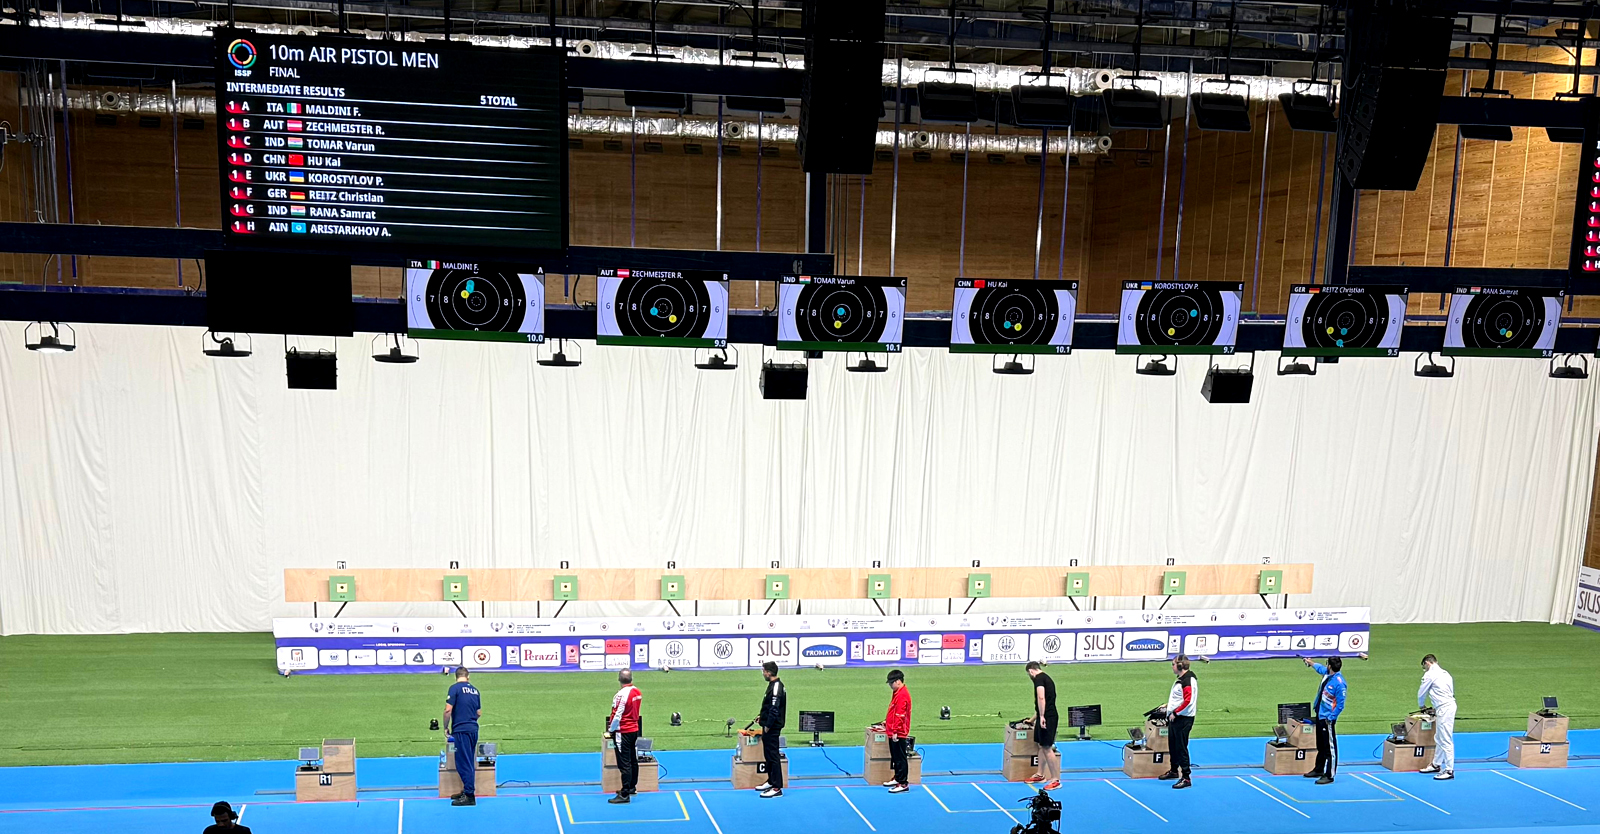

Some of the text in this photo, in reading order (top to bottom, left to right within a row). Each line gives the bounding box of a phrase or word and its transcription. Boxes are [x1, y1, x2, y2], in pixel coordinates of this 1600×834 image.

[270, 45, 438, 68] 10m AIR PISTOL MEN
[270, 67, 300, 78] FINAL
[227, 82, 345, 97] INTERMEDIATE RESULTS
[228, 100, 362, 116] 1 A ITA MALDINI F.
[230, 118, 384, 136] 1 B AUT ZECHMEISTER R.
[230, 136, 374, 152] 1 C IND TOMAR Varun
[232, 152, 340, 166] 1 D CHN HU Kai
[232, 170, 384, 186] 1 E UKR KOROSTYLOV P.
[1594, 172, 1600, 180] 1
[232, 186, 384, 202] 1 F GER REITZ Christian
[1594, 186, 1598, 194] 1
[1592, 202, 1596, 210] 1
[234, 204, 376, 220] 1 G IND RANA Samrat
[1590, 216, 1594, 224] 1
[234, 220, 392, 236] 1 H AIN ARISTARKHOV A.
[1588, 230, 1592, 240] 1
[1586, 246, 1592, 254] 1
[442, 262, 472, 270] MALDINI
[1586, 260, 1590, 268] 1
[632, 270, 676, 278] ZECHMEISTER
[1154, 282, 1194, 290] KOROSTYLOV
[430, 294, 434, 302] 7
[444, 296, 448, 304] 8
[518, 298, 522, 306] 7
[632, 302, 636, 310] 8
[690, 304, 694, 312] 8
[714, 306, 720, 314] 6
[892, 310, 896, 318] 6
[960, 312, 966, 320] 6
[974, 312, 978, 320] 7
[526, 334, 544, 342] 10.0
[714, 340, 726, 348] 9.9
[886, 344, 900, 352] 10.1
[1084, 635, 1114, 650] SIUS
[757, 640, 790, 656] SIUS
[866, 644, 898, 656] Perazzi
[524, 650, 558, 660] Perazzi
[990, 652, 1022, 660] BERETTA
[1298, 750, 1304, 758] G
[1416, 748, 1422, 756] H
[1540, 744, 1552, 754] R2
[1156, 754, 1162, 762] F
[760, 764, 766, 772] C
[320, 774, 332, 784] R1
